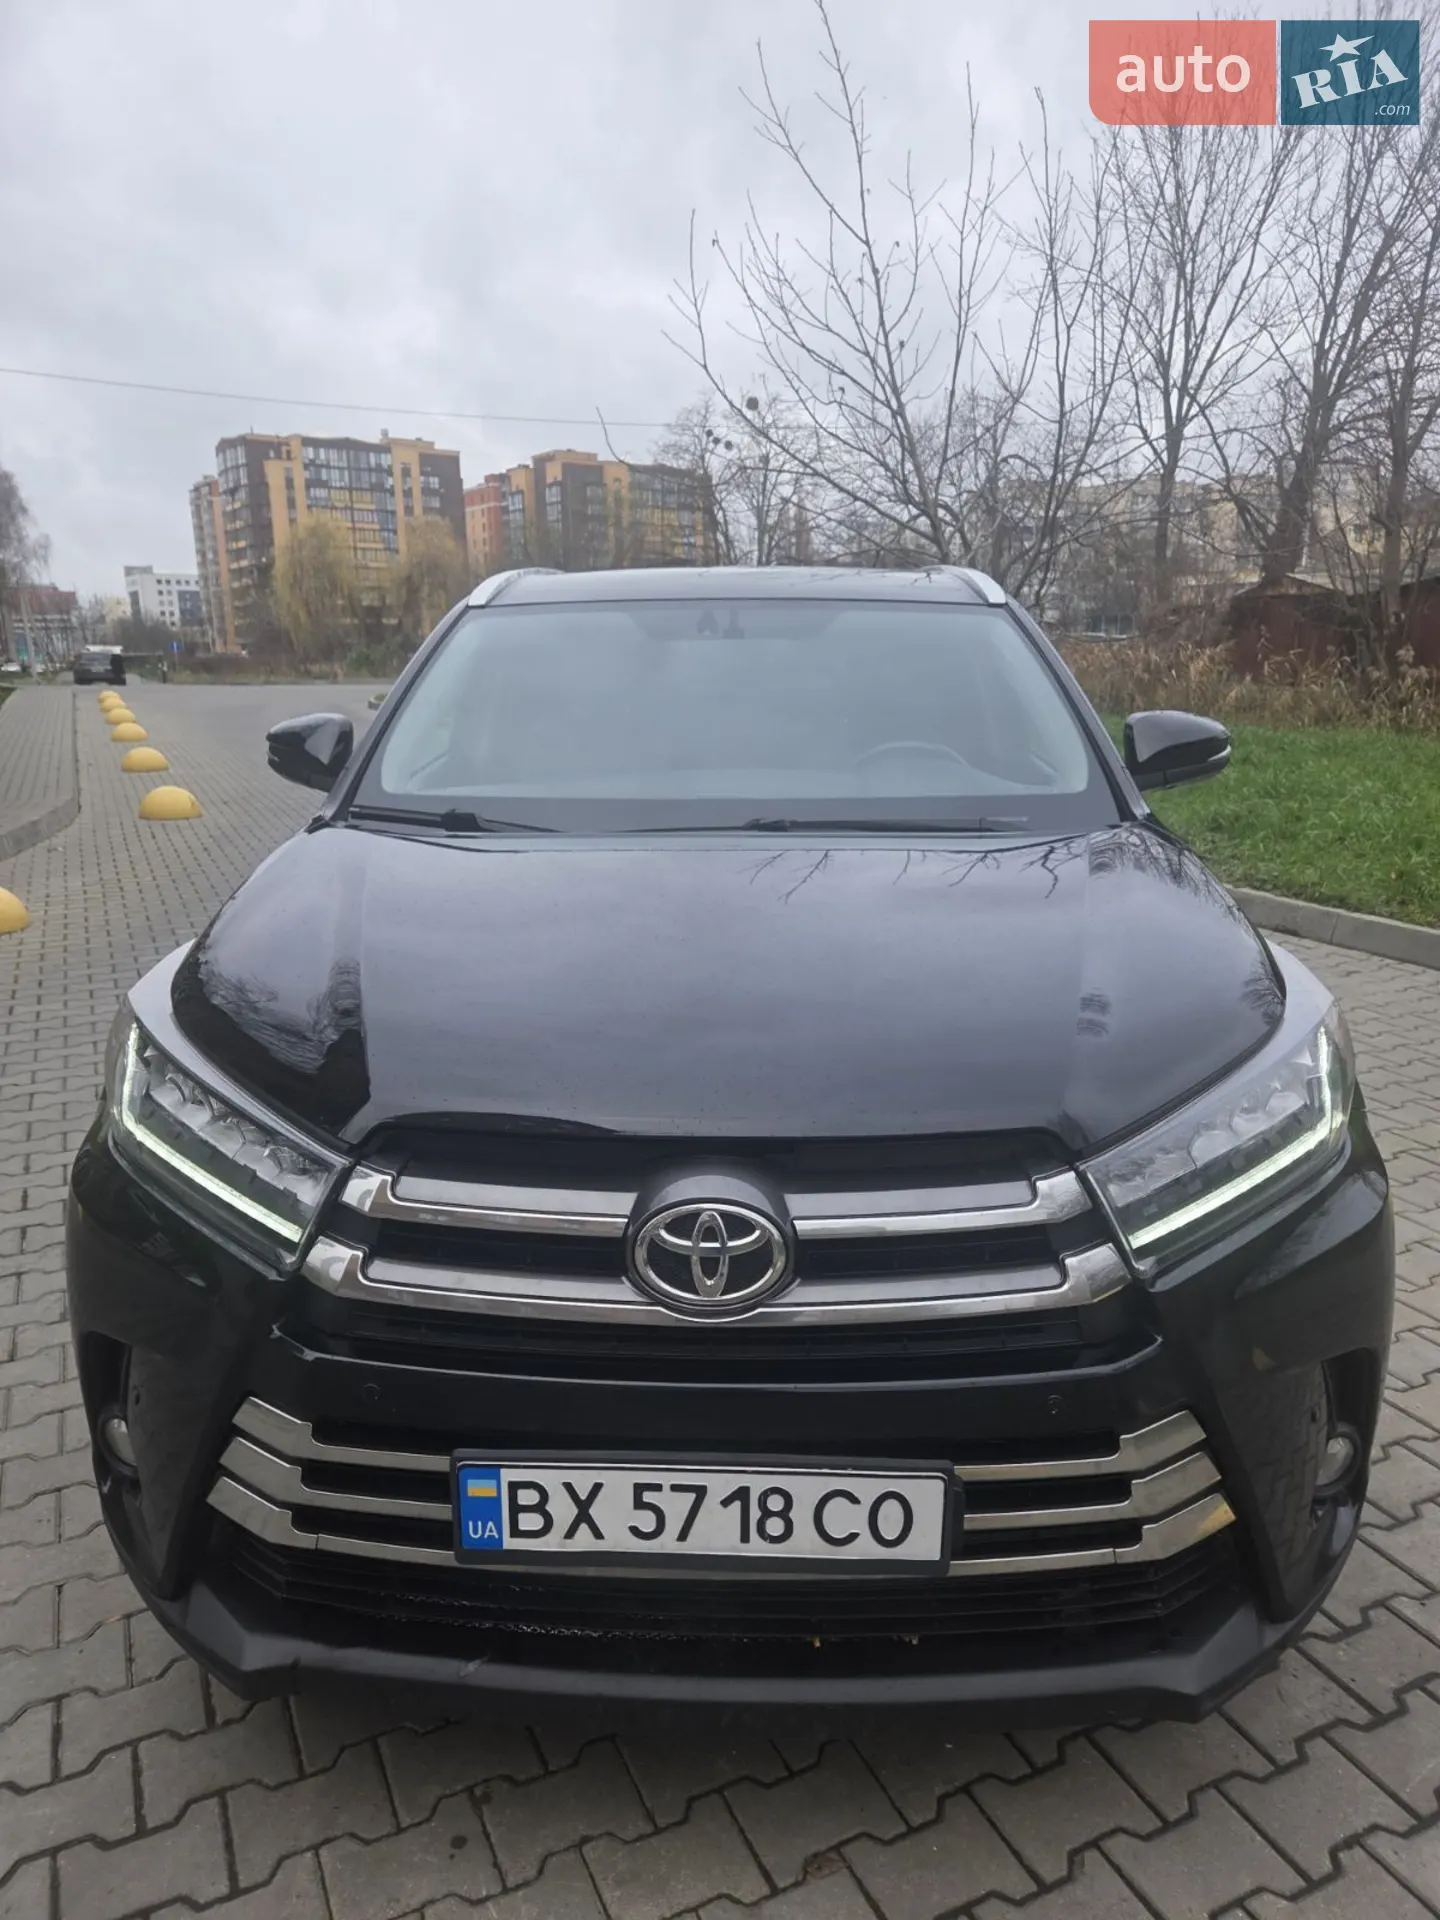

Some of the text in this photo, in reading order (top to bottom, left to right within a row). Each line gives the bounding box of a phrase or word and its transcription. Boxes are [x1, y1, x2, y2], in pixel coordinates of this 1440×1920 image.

[468, 1520, 499, 1540] UA
[507, 1480, 914, 1548] BX 5718 CO
